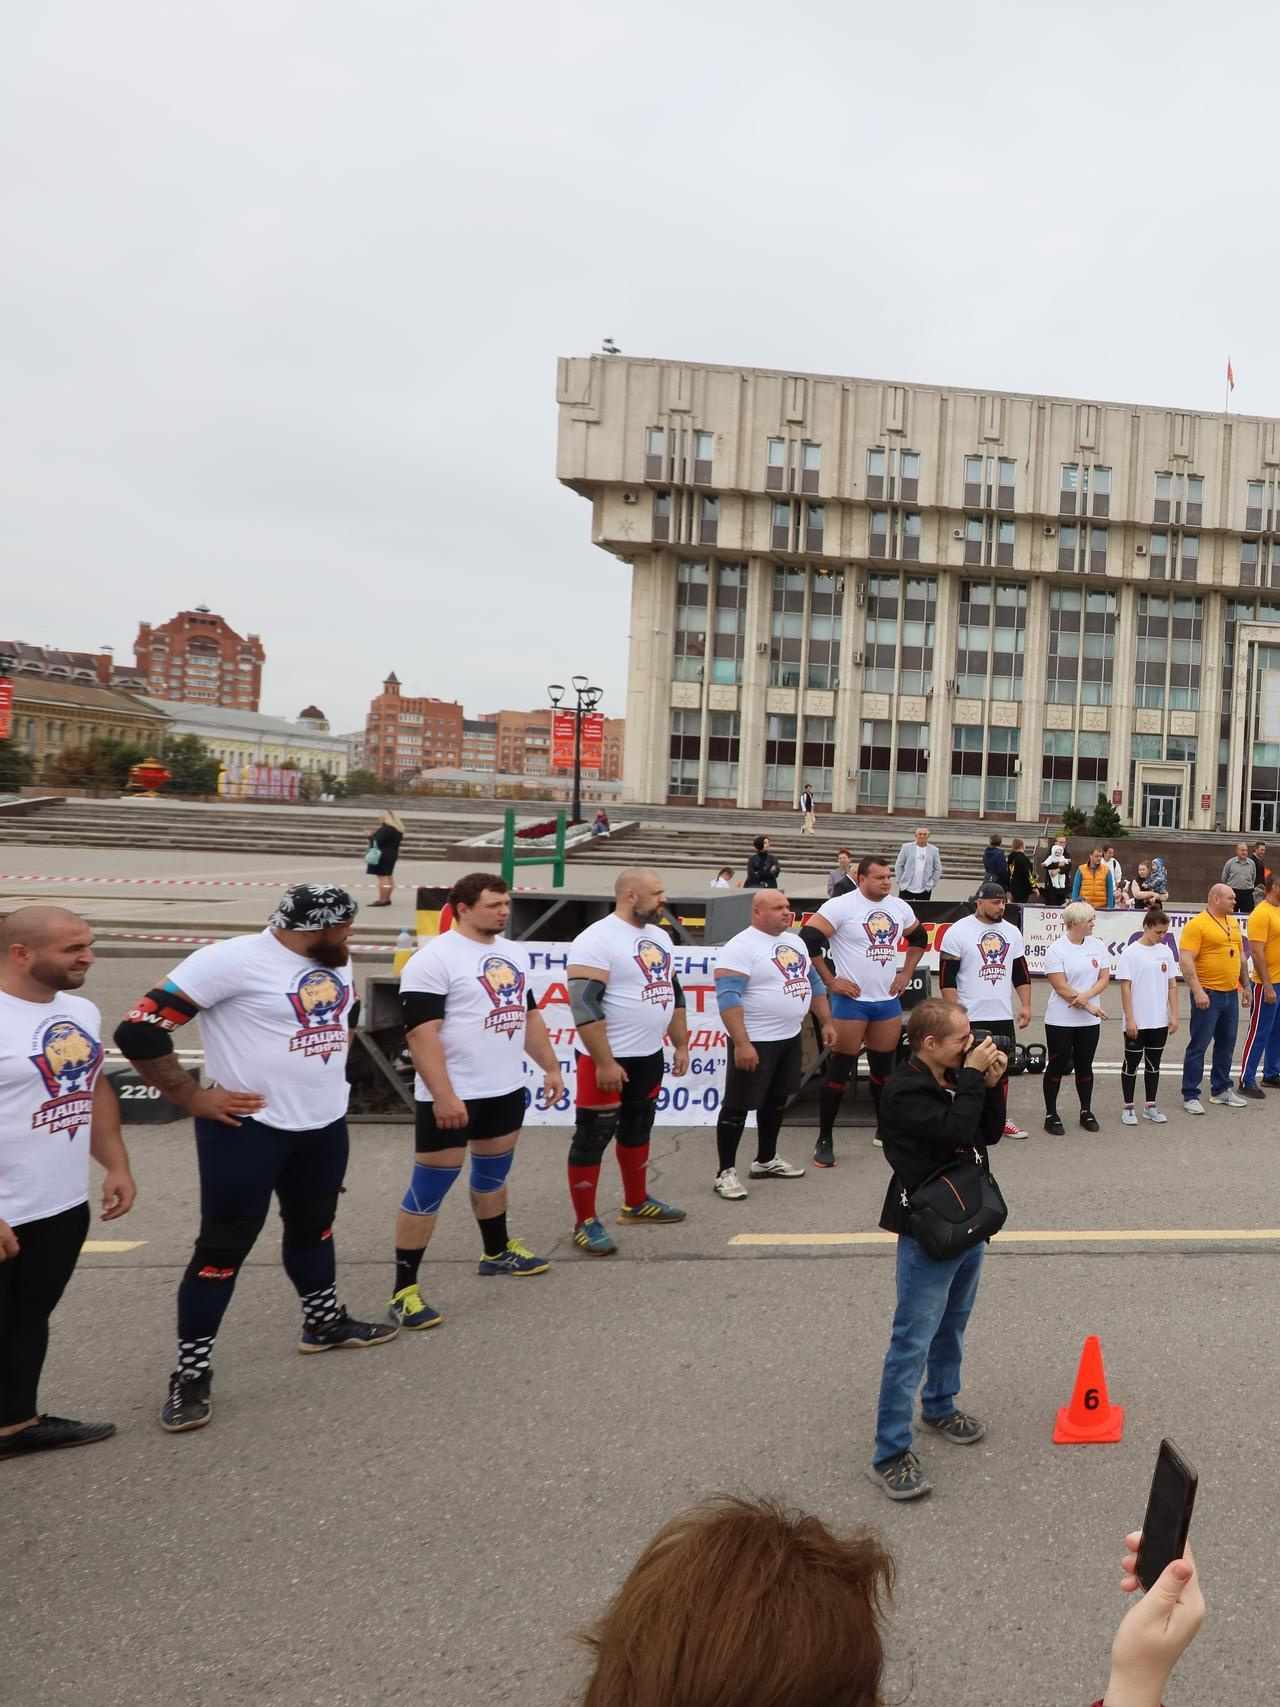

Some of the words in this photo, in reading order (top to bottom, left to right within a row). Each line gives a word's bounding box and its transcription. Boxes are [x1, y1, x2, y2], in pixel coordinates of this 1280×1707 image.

[1040, 912, 1057, 920] 300
[1024, 944, 1050, 957] 8-95
[306, 1042, 342, 1055] МИРА
[1030, 1056, 1040, 1064] 24
[120, 1084, 161, 1100] 220
[655, 1086, 719, 1112] 90-0
[1084, 1388, 1100, 1410] 6
